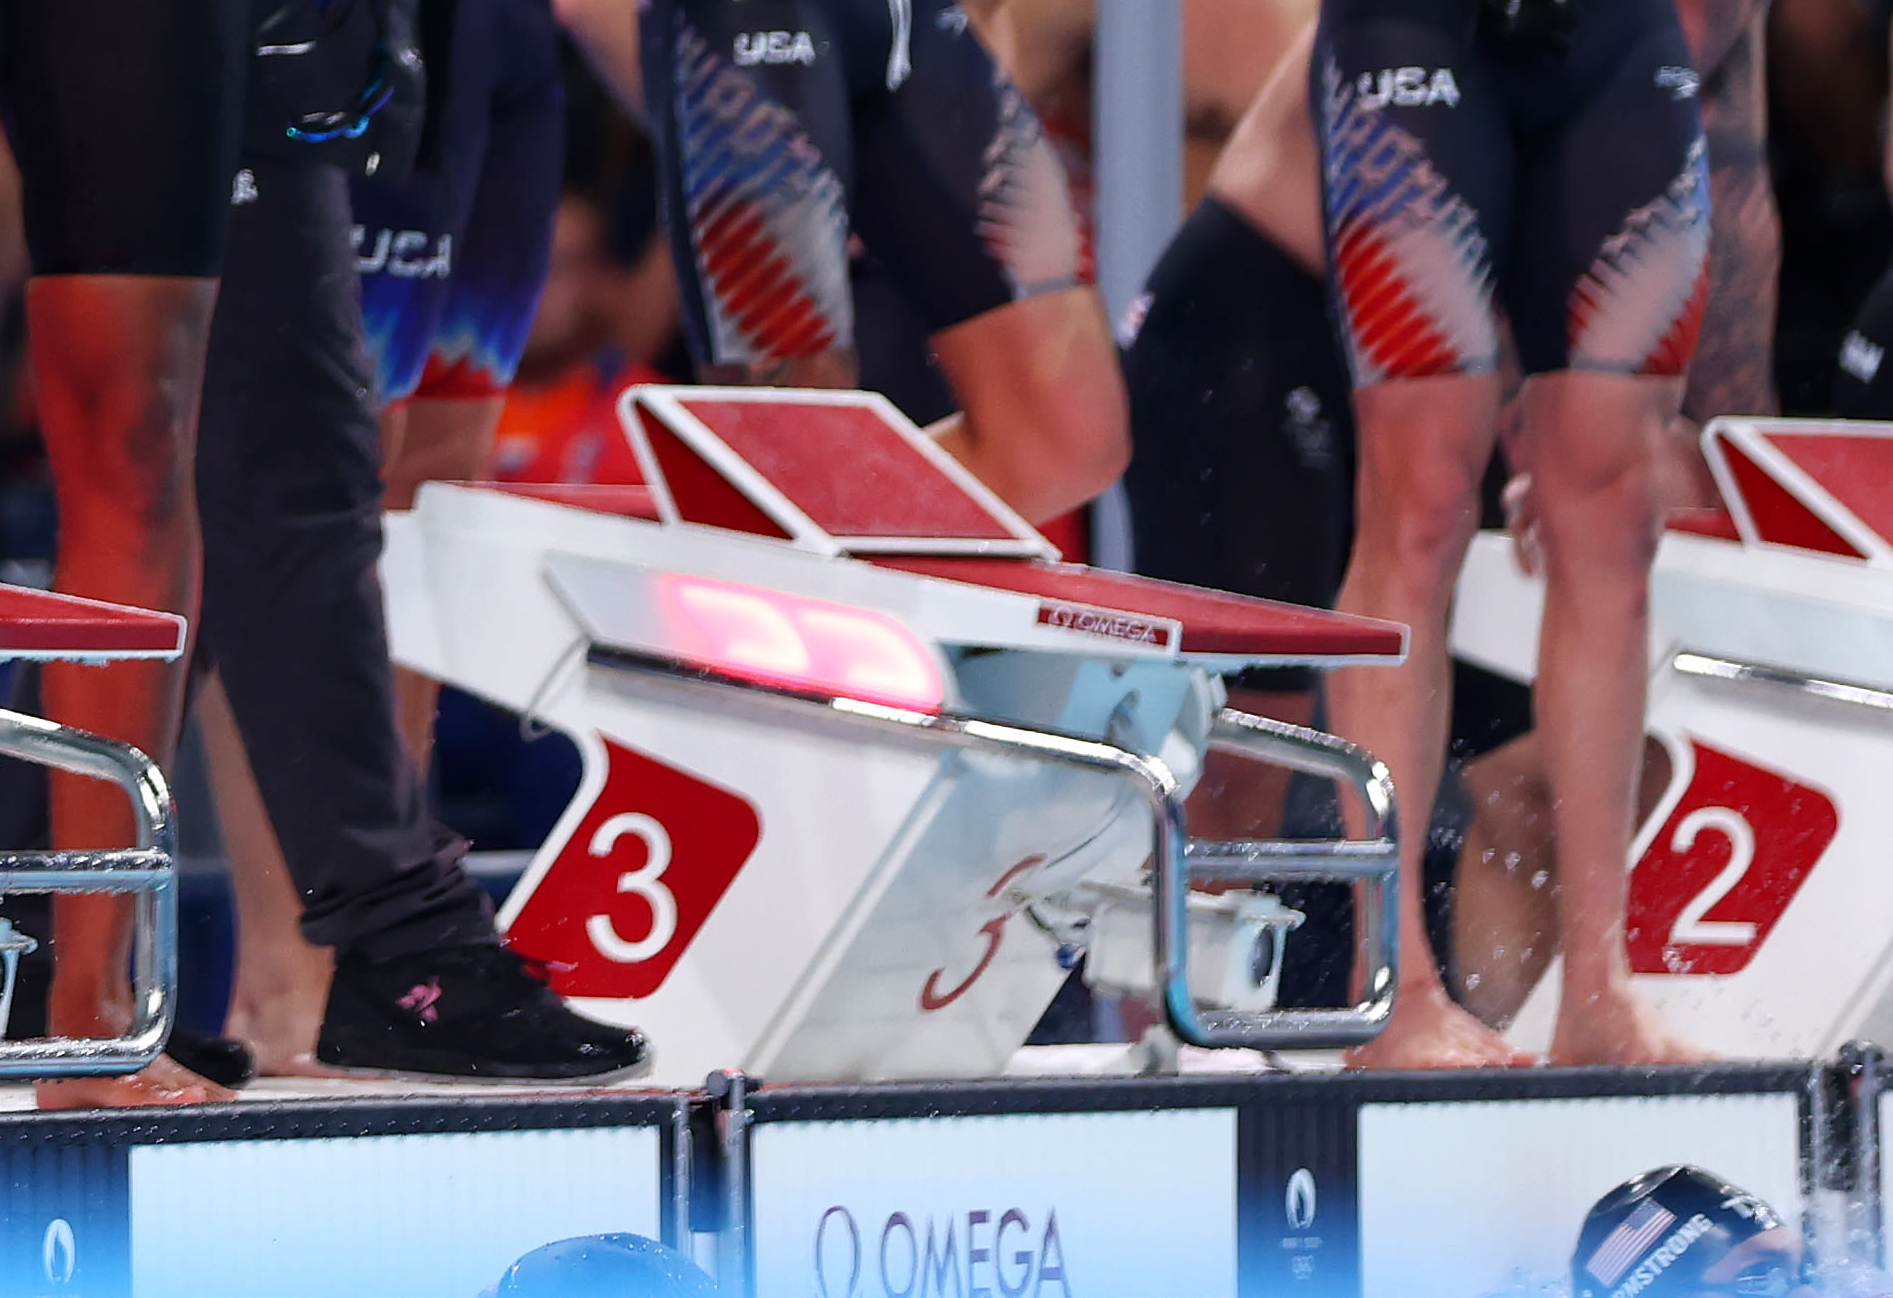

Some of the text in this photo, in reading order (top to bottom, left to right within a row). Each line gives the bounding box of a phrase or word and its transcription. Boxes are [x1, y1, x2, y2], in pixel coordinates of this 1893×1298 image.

[1075, 612, 1158, 642] OMEGA
[585, 811, 677, 964] 3
[1669, 805, 1757, 947] 2
[880, 1205, 1075, 1298] OMEGA
